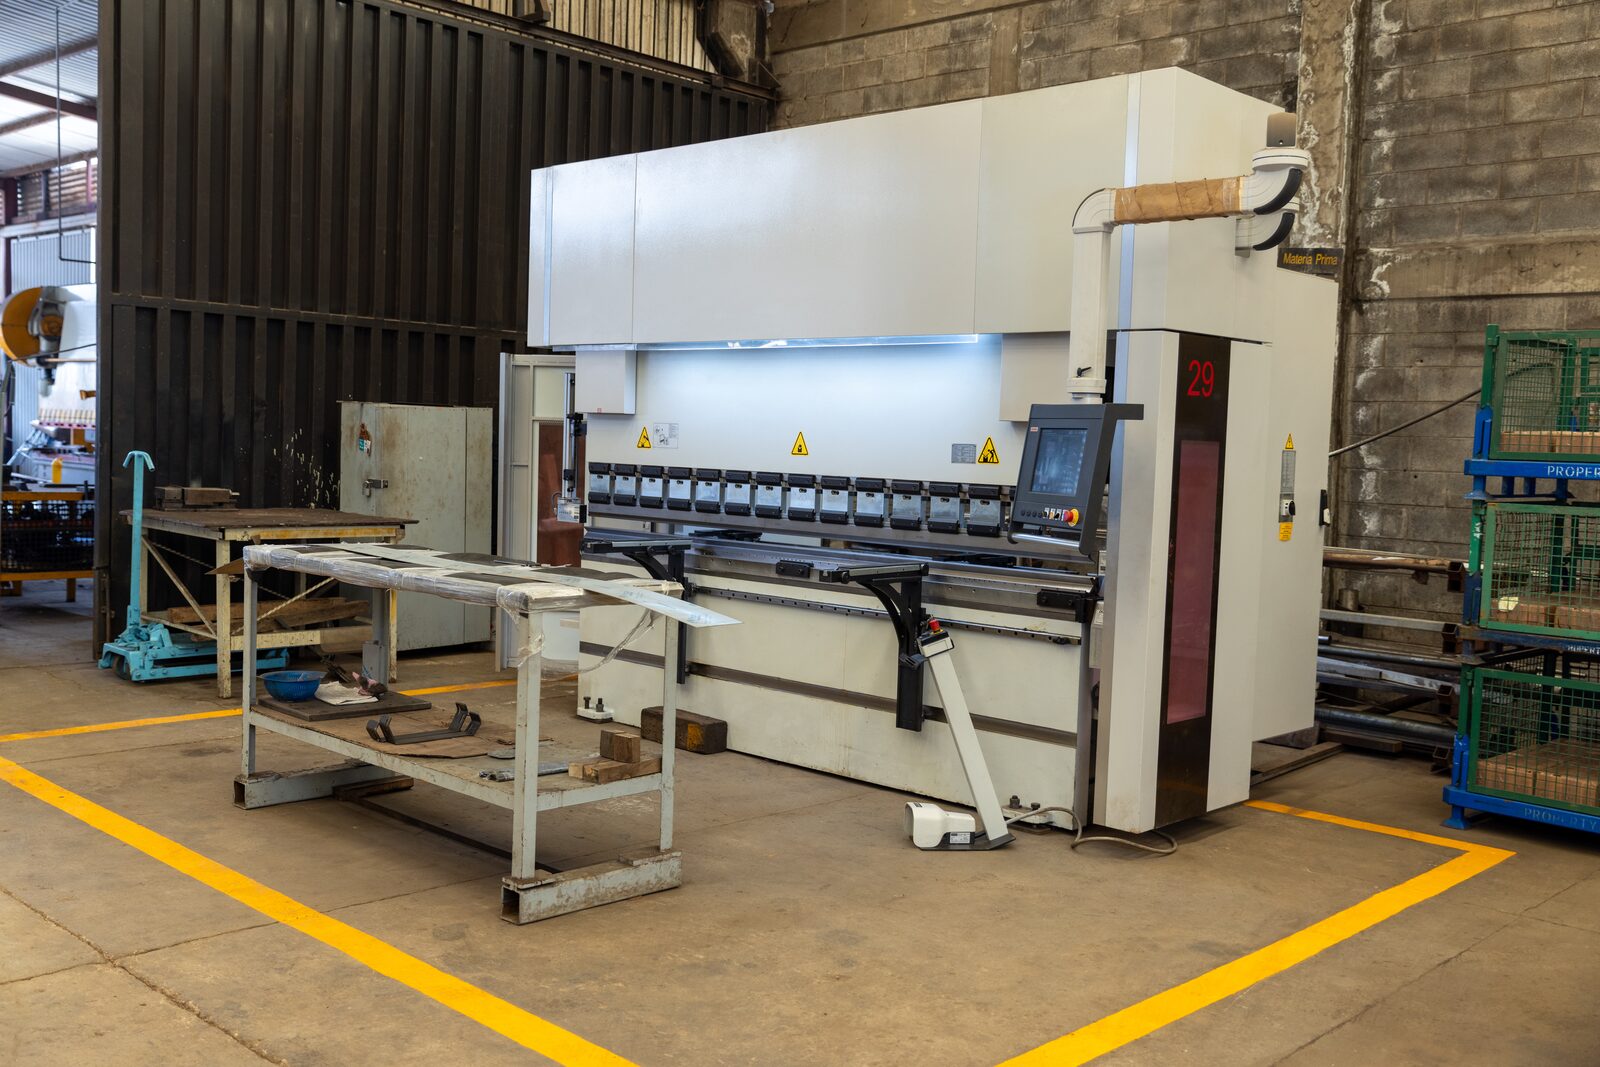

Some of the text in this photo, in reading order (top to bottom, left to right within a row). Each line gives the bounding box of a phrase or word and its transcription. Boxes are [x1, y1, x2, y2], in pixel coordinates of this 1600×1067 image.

[1283, 252, 1338, 265] Materia Prima
[1187, 359, 1215, 397] 29
